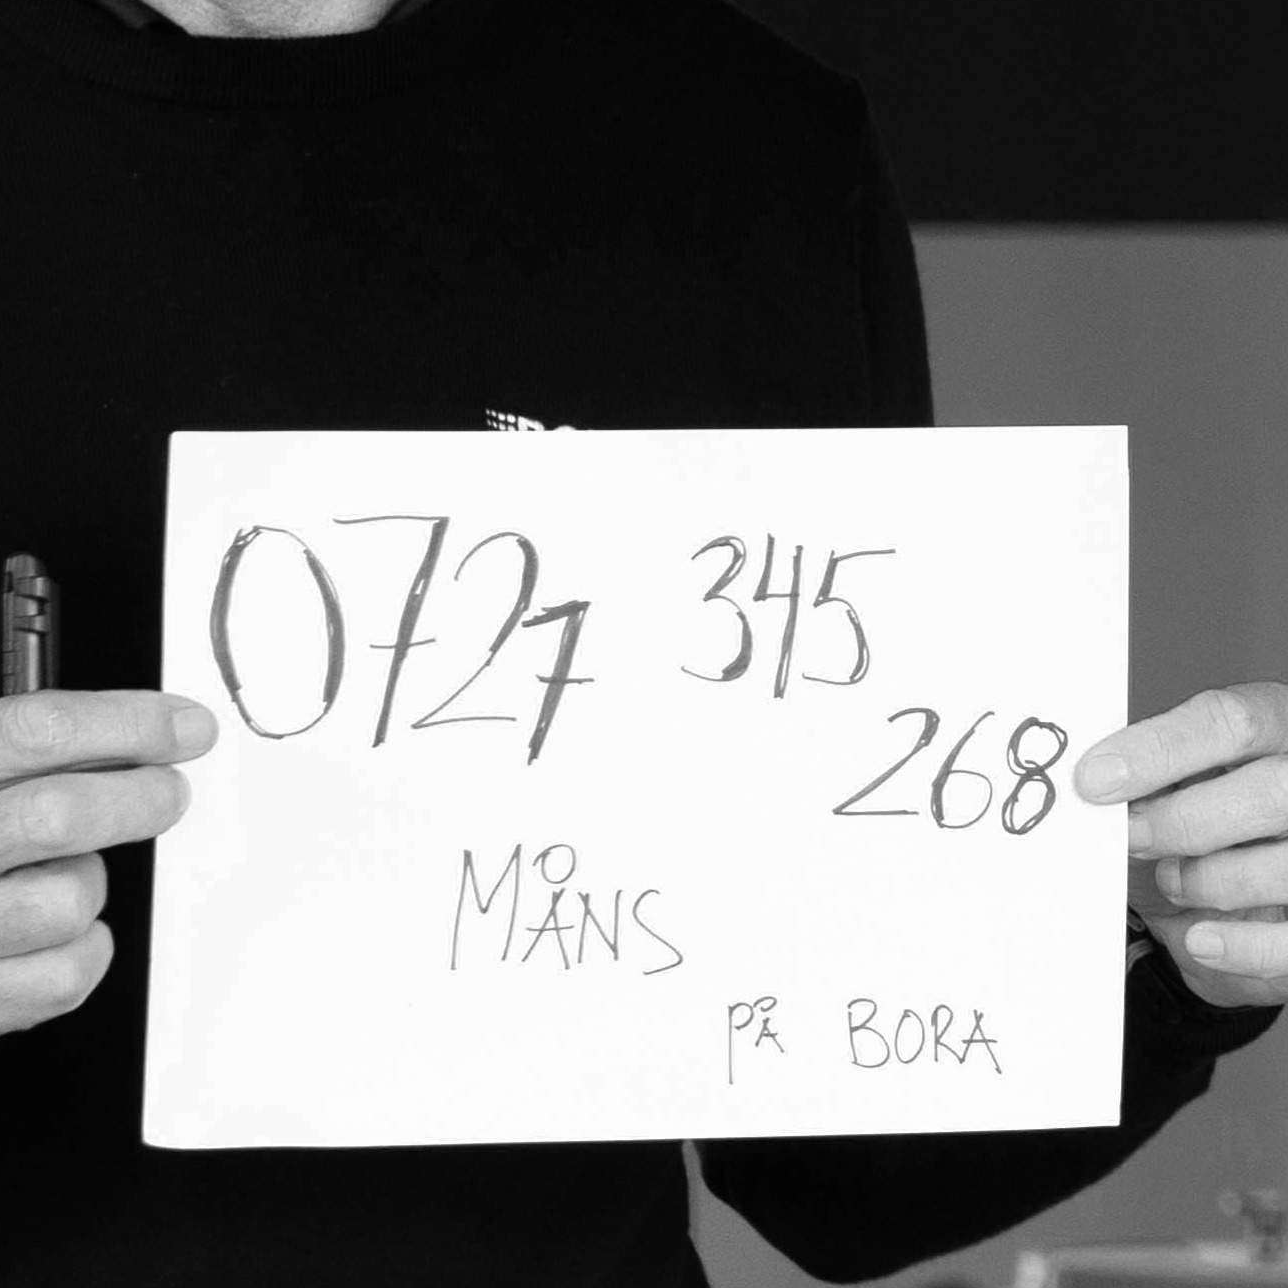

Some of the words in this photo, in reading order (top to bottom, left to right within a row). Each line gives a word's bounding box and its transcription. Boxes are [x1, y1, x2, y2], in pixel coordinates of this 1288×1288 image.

[209, 515, 595, 766] 0727
[680, 532, 897, 700] 345
[831, 707, 1069, 836] 268
[450, 843, 684, 976] MÅNS
[847, 997, 1003, 1075] BORA
